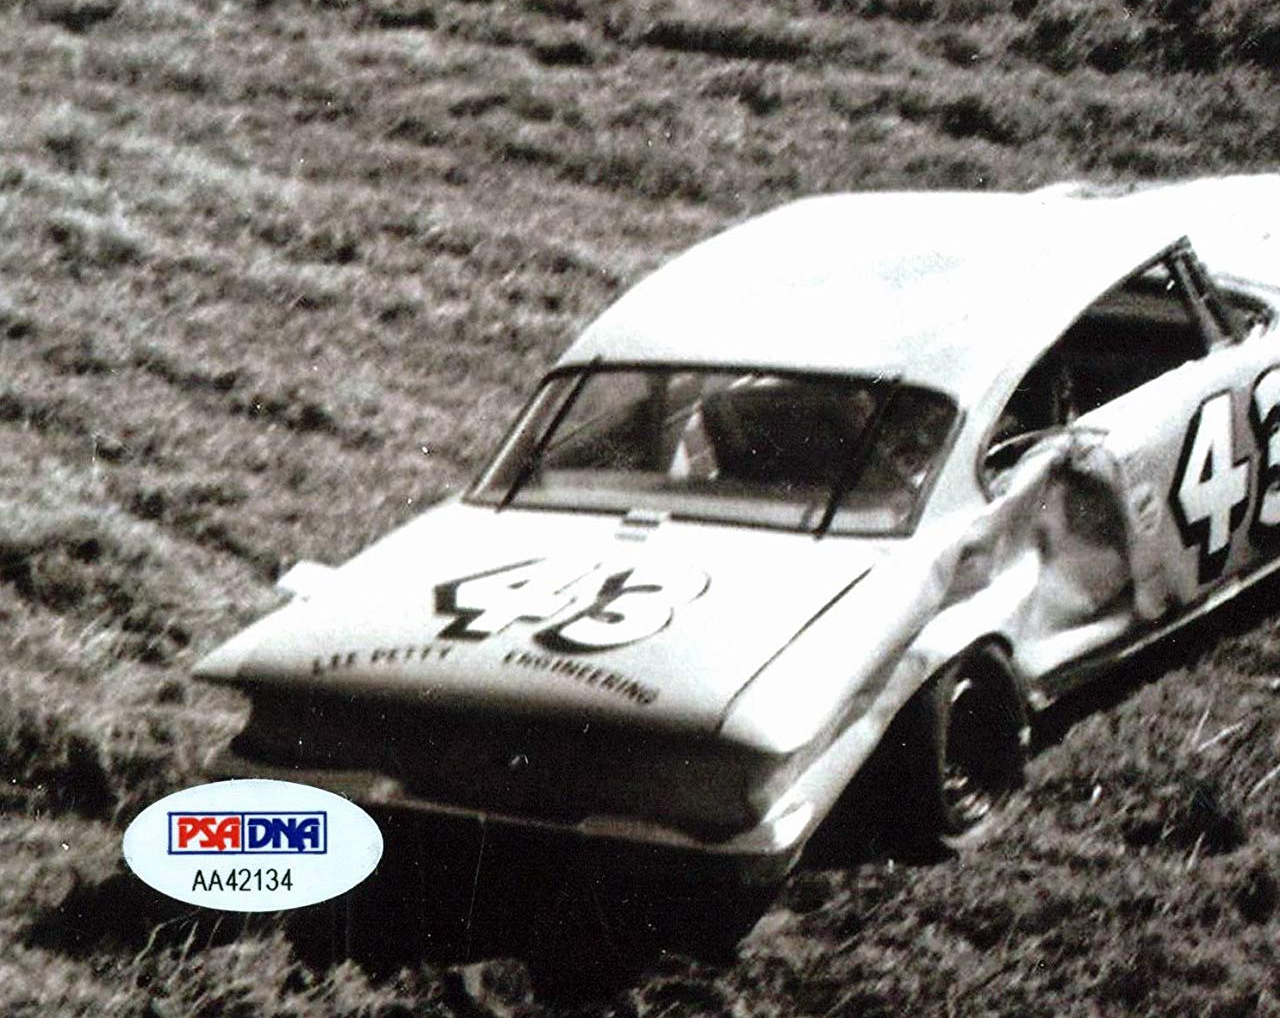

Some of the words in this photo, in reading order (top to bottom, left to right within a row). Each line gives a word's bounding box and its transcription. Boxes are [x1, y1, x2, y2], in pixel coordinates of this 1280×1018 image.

[432, 556, 712, 655] 43
[311, 650, 357, 677] LEE
[369, 644, 453, 665] PETTY
[502, 650, 661, 705] ENGINEERING
[177, 816, 241, 851] PSA
[246, 817, 321, 852] DNA
[191, 868, 294, 892] AA42134
